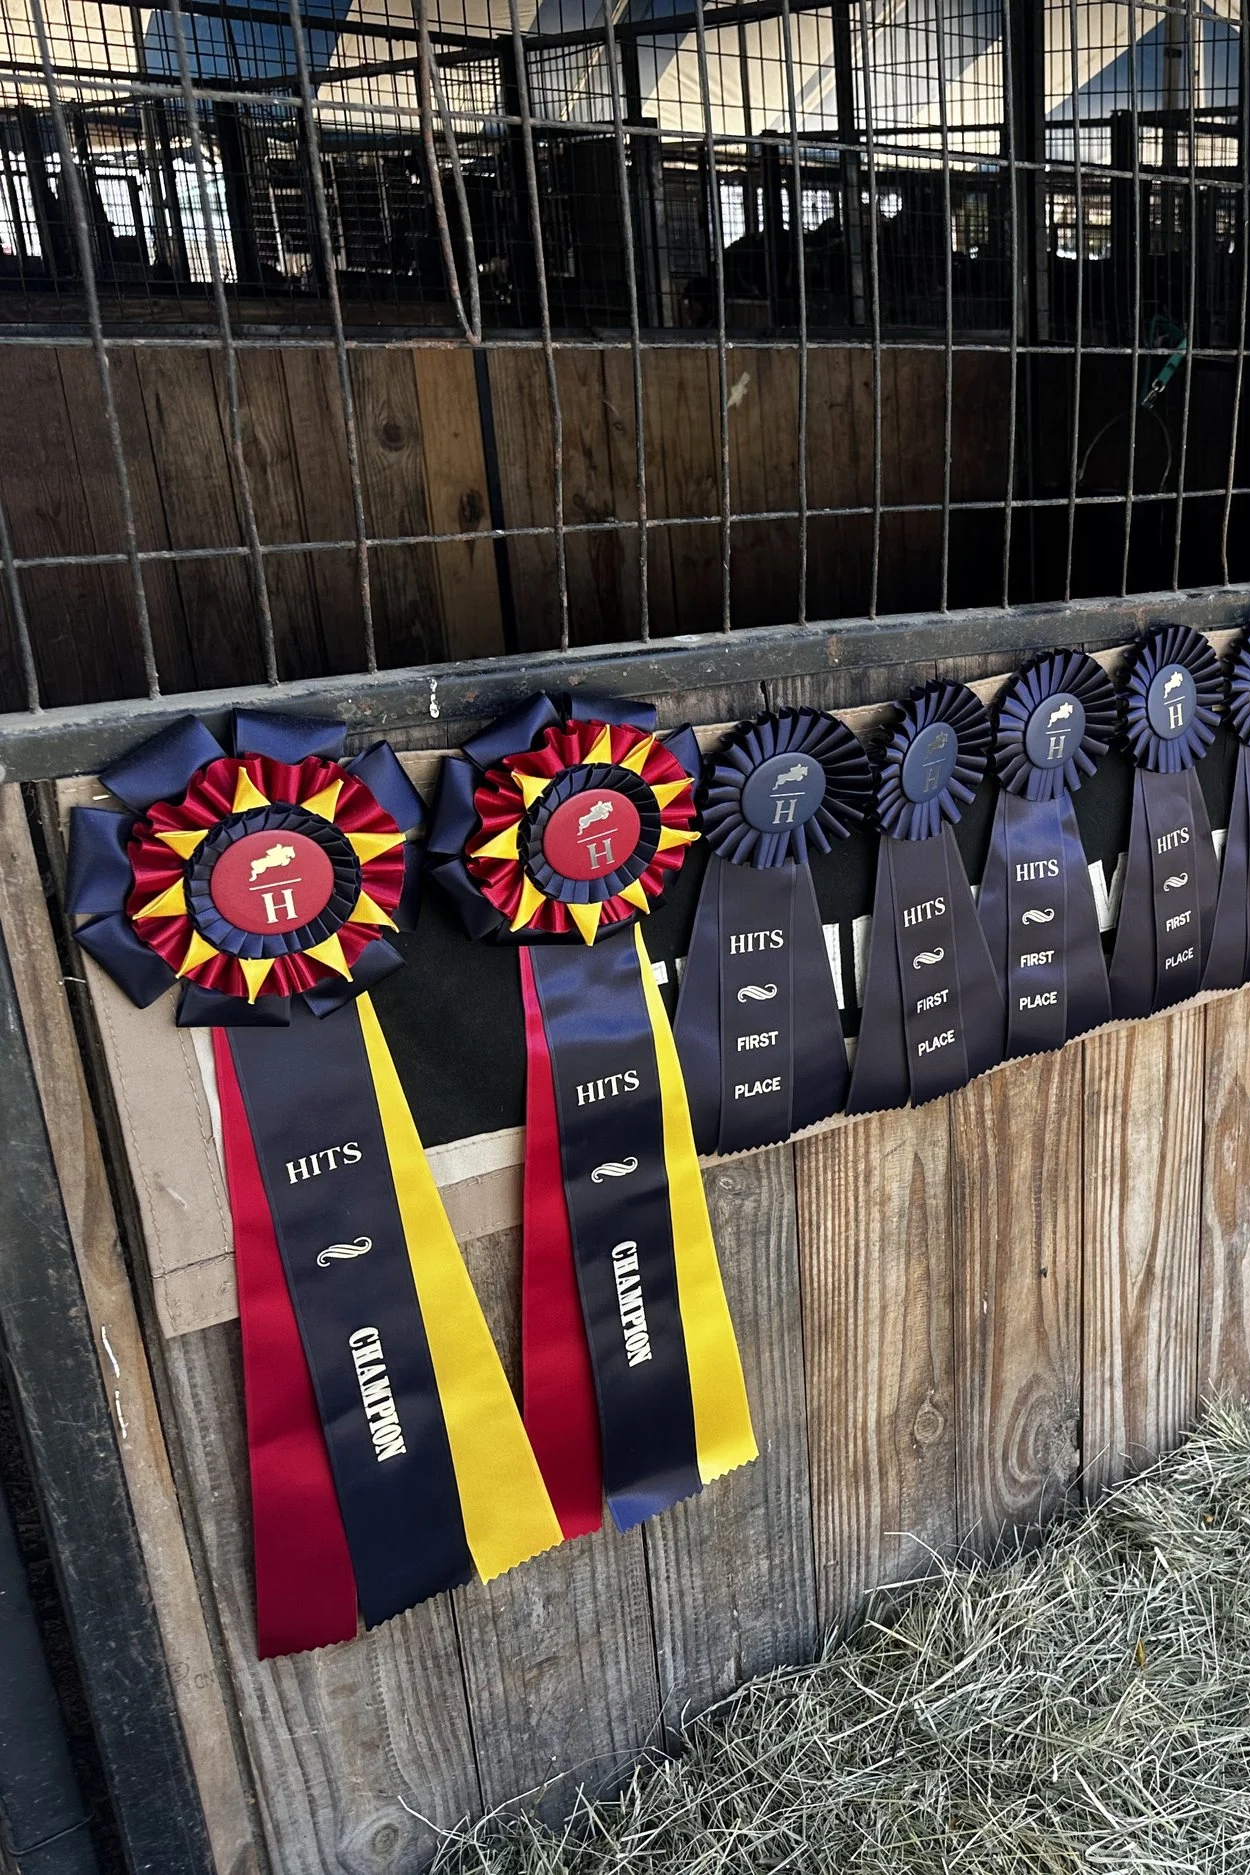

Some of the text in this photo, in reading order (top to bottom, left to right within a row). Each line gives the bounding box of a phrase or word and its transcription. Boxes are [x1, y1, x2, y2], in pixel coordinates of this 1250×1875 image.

[1168, 704, 1184, 730] H
[1046, 735, 1067, 760] H
[922, 766, 942, 793] H
[771, 799, 799, 824] H
[1157, 827, 1190, 854] HITS
[586, 839, 616, 870] H
[1015, 859, 1059, 882] HITS
[261, 888, 298, 924] H
[902, 897, 946, 927] HITS
[1165, 910, 1192, 933] FIRST
[729, 929, 785, 955] HITS
[1020, 950, 1055, 969] FIRST
[1165, 947, 1194, 970] PLACE
[916, 989, 949, 1014] FIRST
[1018, 991, 1058, 1011] PLACE
[736, 1031, 779, 1052] FIRST
[917, 1030, 956, 1056] PLACE
[575, 1069, 641, 1106] HITS
[734, 1076, 782, 1100] PLACE
[285, 1140, 363, 1185] HITS
[610, 1239, 653, 1368] CHAMPION
[347, 1325, 407, 1463] CHAMPION
